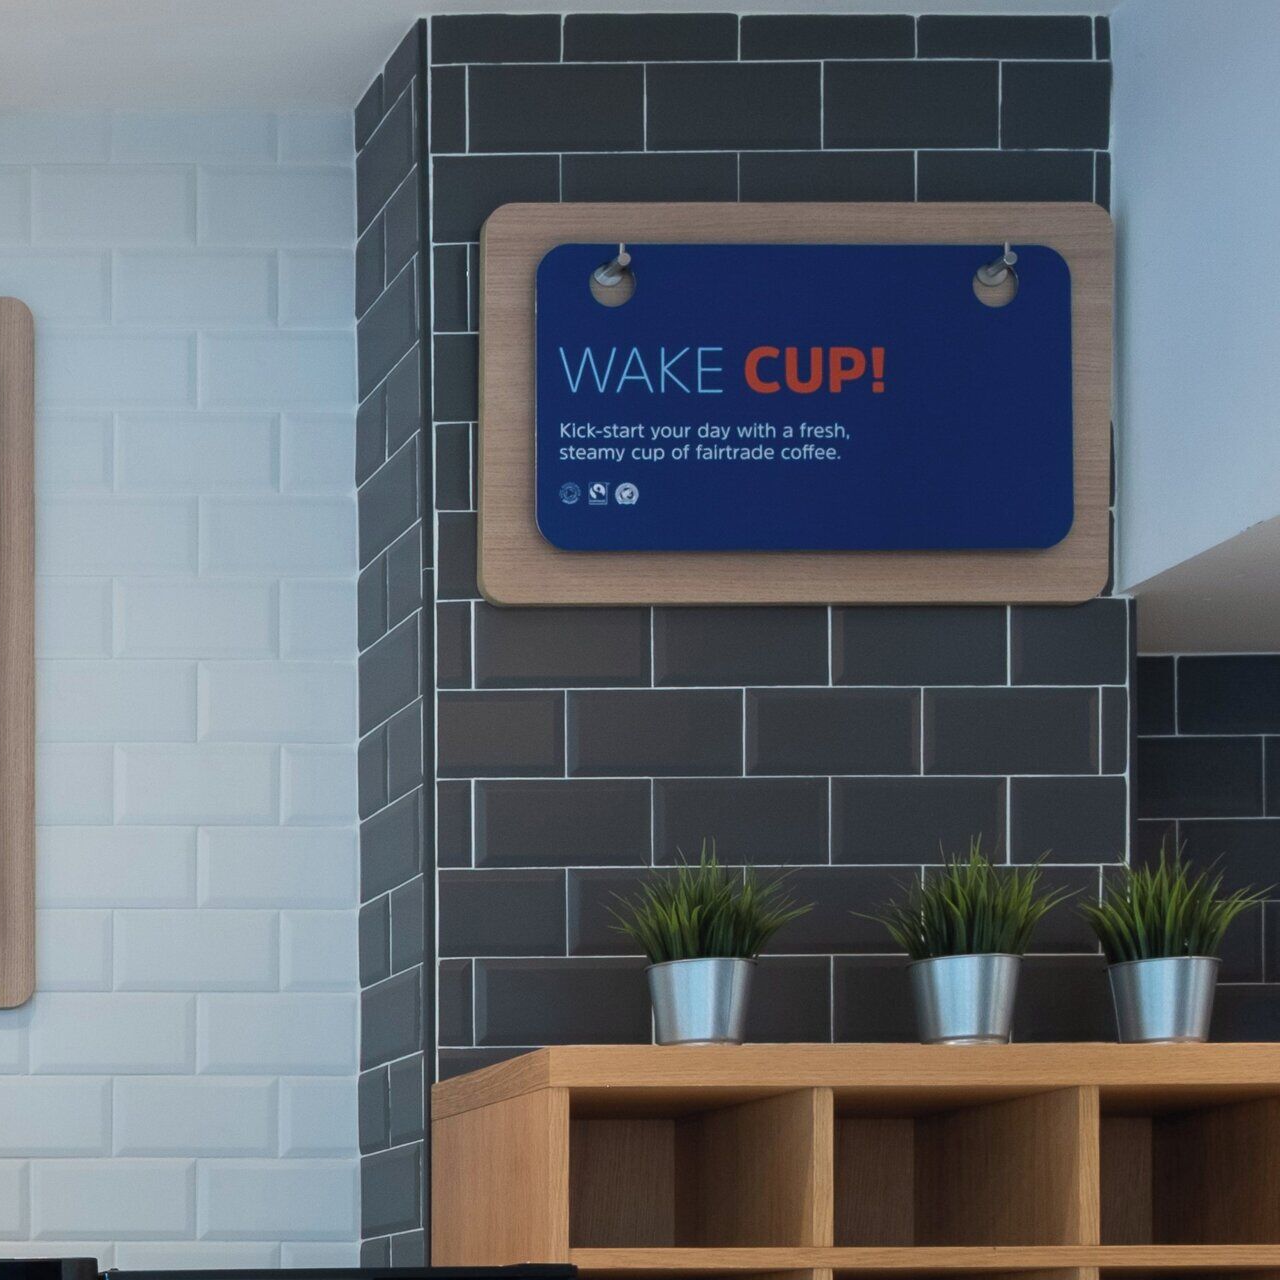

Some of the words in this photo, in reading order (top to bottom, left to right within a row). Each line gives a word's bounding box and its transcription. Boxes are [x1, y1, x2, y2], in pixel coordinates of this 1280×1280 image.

[559, 347, 723, 393] WAKE
[744, 345, 885, 394] CUP!
[561, 423, 644, 438] Kick-start
[651, 426, 691, 440] your
[698, 423, 730, 440] day
[737, 423, 776, 438] with
[783, 426, 793, 438] a
[800, 423, 849, 439] fresh,
[560, 446, 625, 462] steamy
[632, 448, 665, 461] cup
[672, 444, 690, 460] of
[696, 444, 774, 460] fairtrade
[781, 444, 840, 460] coffee.
